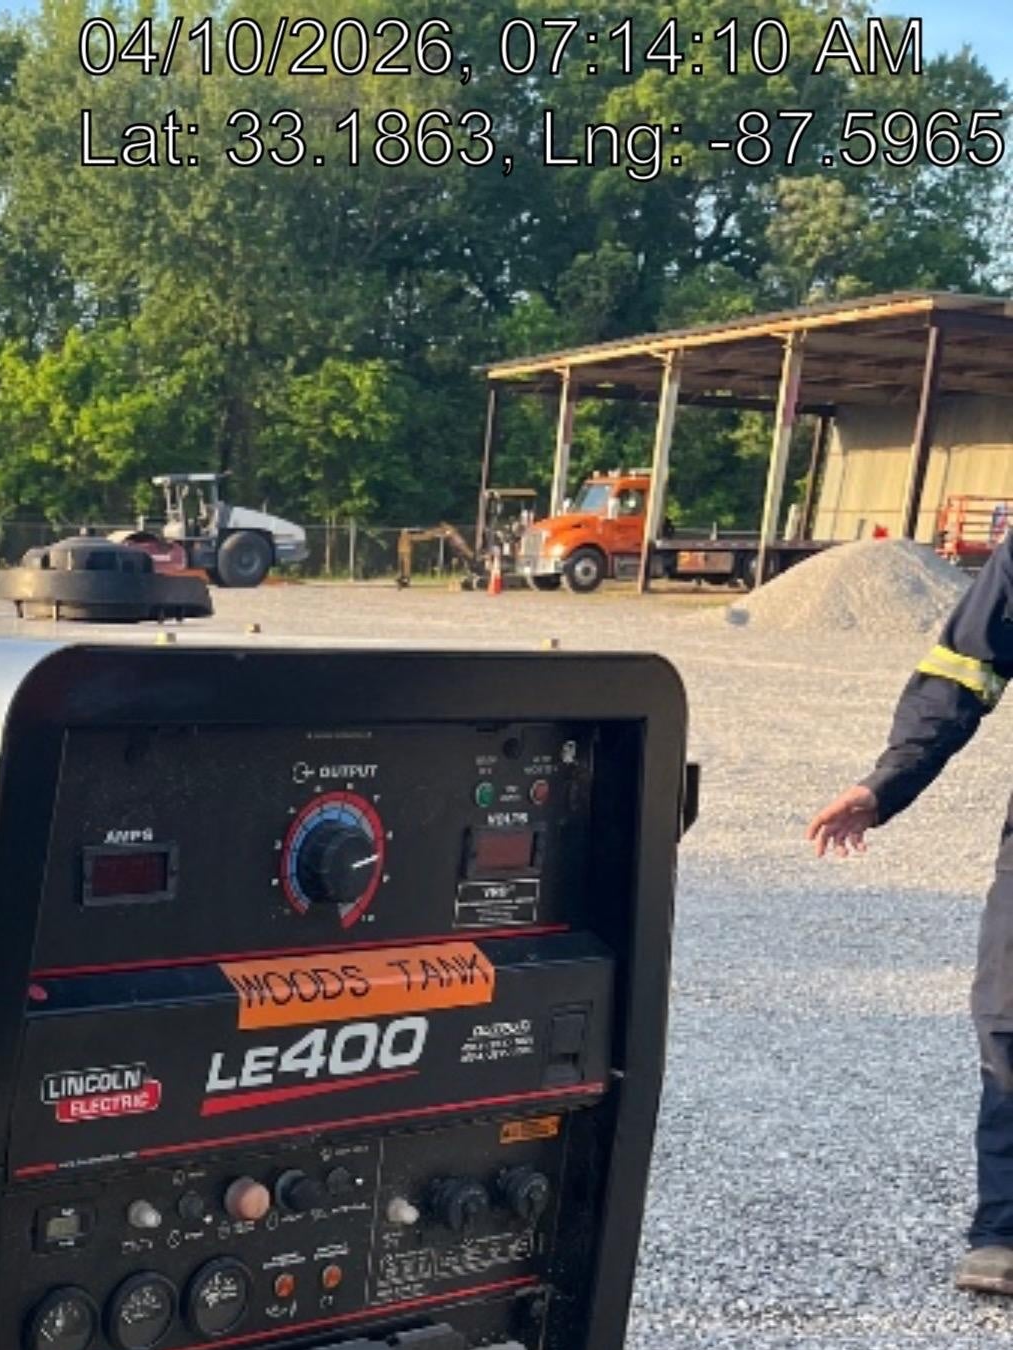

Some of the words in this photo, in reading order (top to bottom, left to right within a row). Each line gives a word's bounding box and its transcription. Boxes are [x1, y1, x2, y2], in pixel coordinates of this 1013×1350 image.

[319, 764, 378, 779] OUTPUT
[488, 812, 529, 826] VOLTS
[103, 827, 154, 844] AMPS
[231, 965, 372, 1008] WOODS
[386, 953, 489, 993] TANK
[204, 1015, 430, 1094] LE400
[48, 1070, 142, 1099] LINCOLN
[70, 1091, 150, 1117] ELECTRIC
